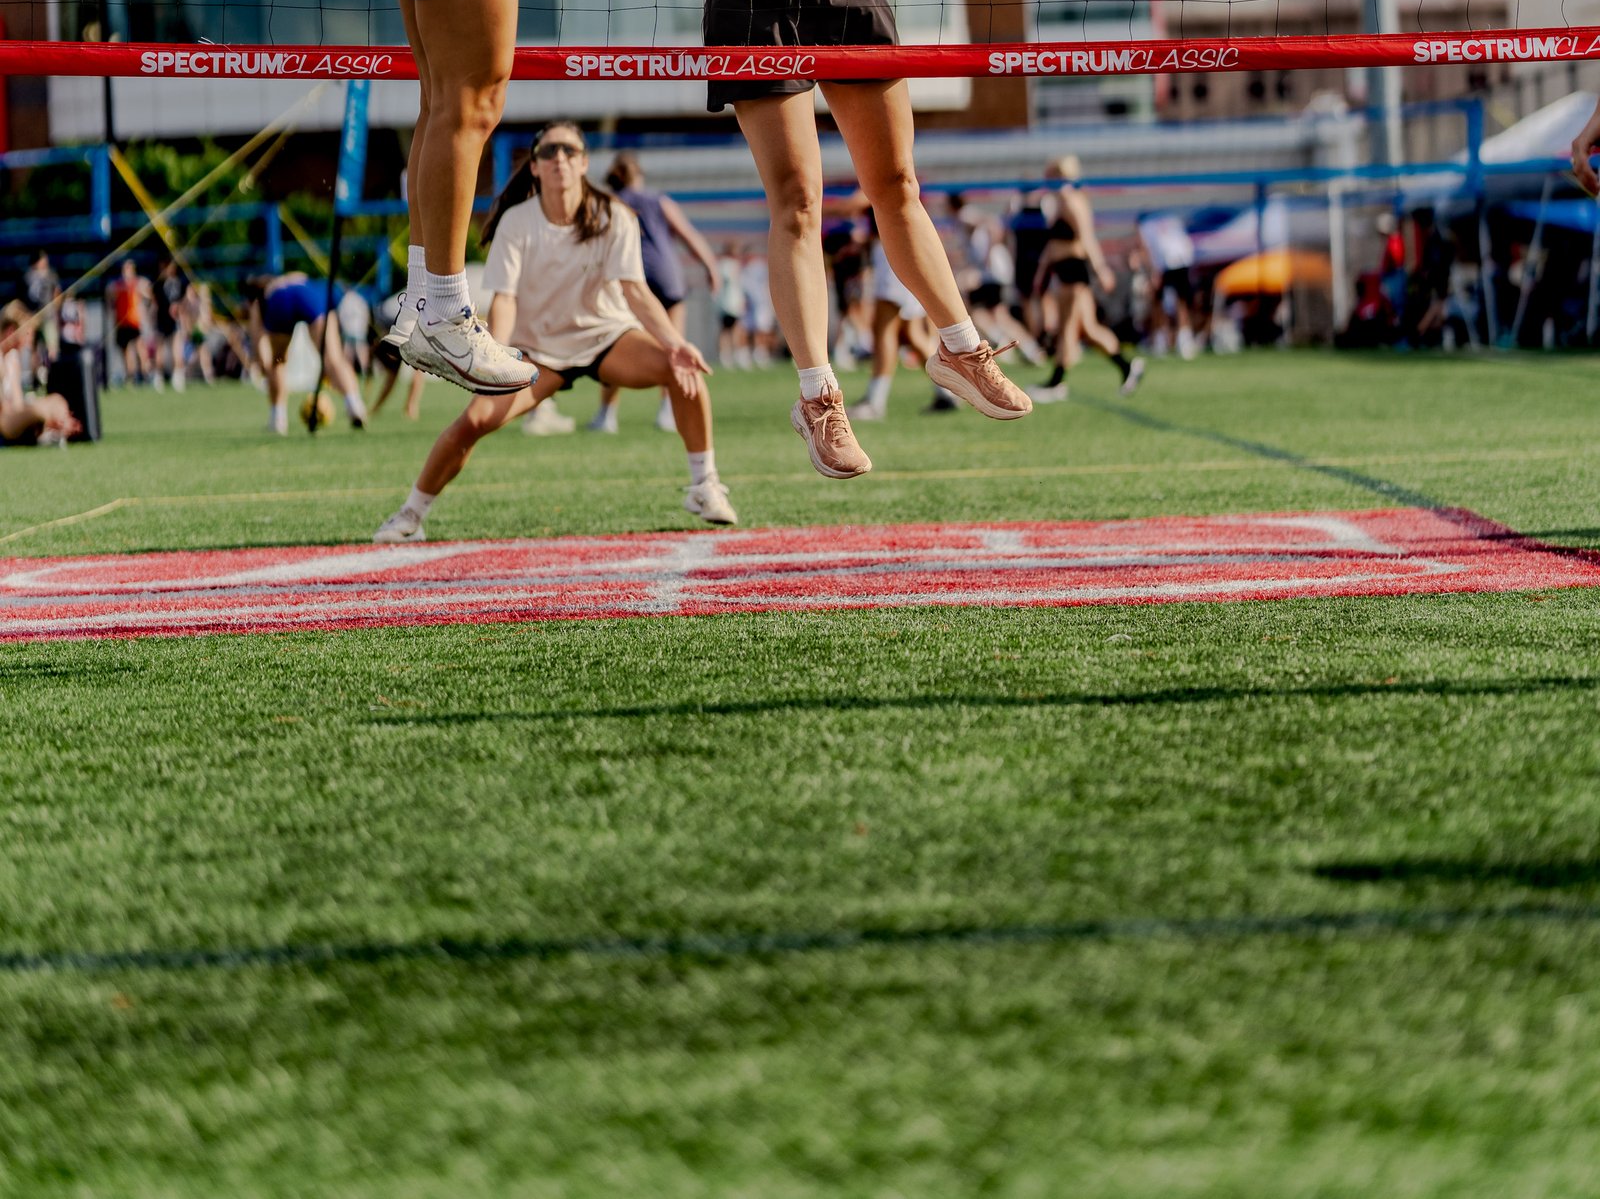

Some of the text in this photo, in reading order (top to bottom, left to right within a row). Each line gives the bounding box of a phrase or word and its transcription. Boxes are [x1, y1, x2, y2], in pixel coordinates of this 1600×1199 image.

[988, 47, 1239, 74] SPECTRUM CLASSIC
[1413, 36, 1556, 63] SPECTRUM
[140, 52, 392, 75] SPECTRUM CLASSIC
[565, 54, 816, 77] SPECTRUM CLASSIC
